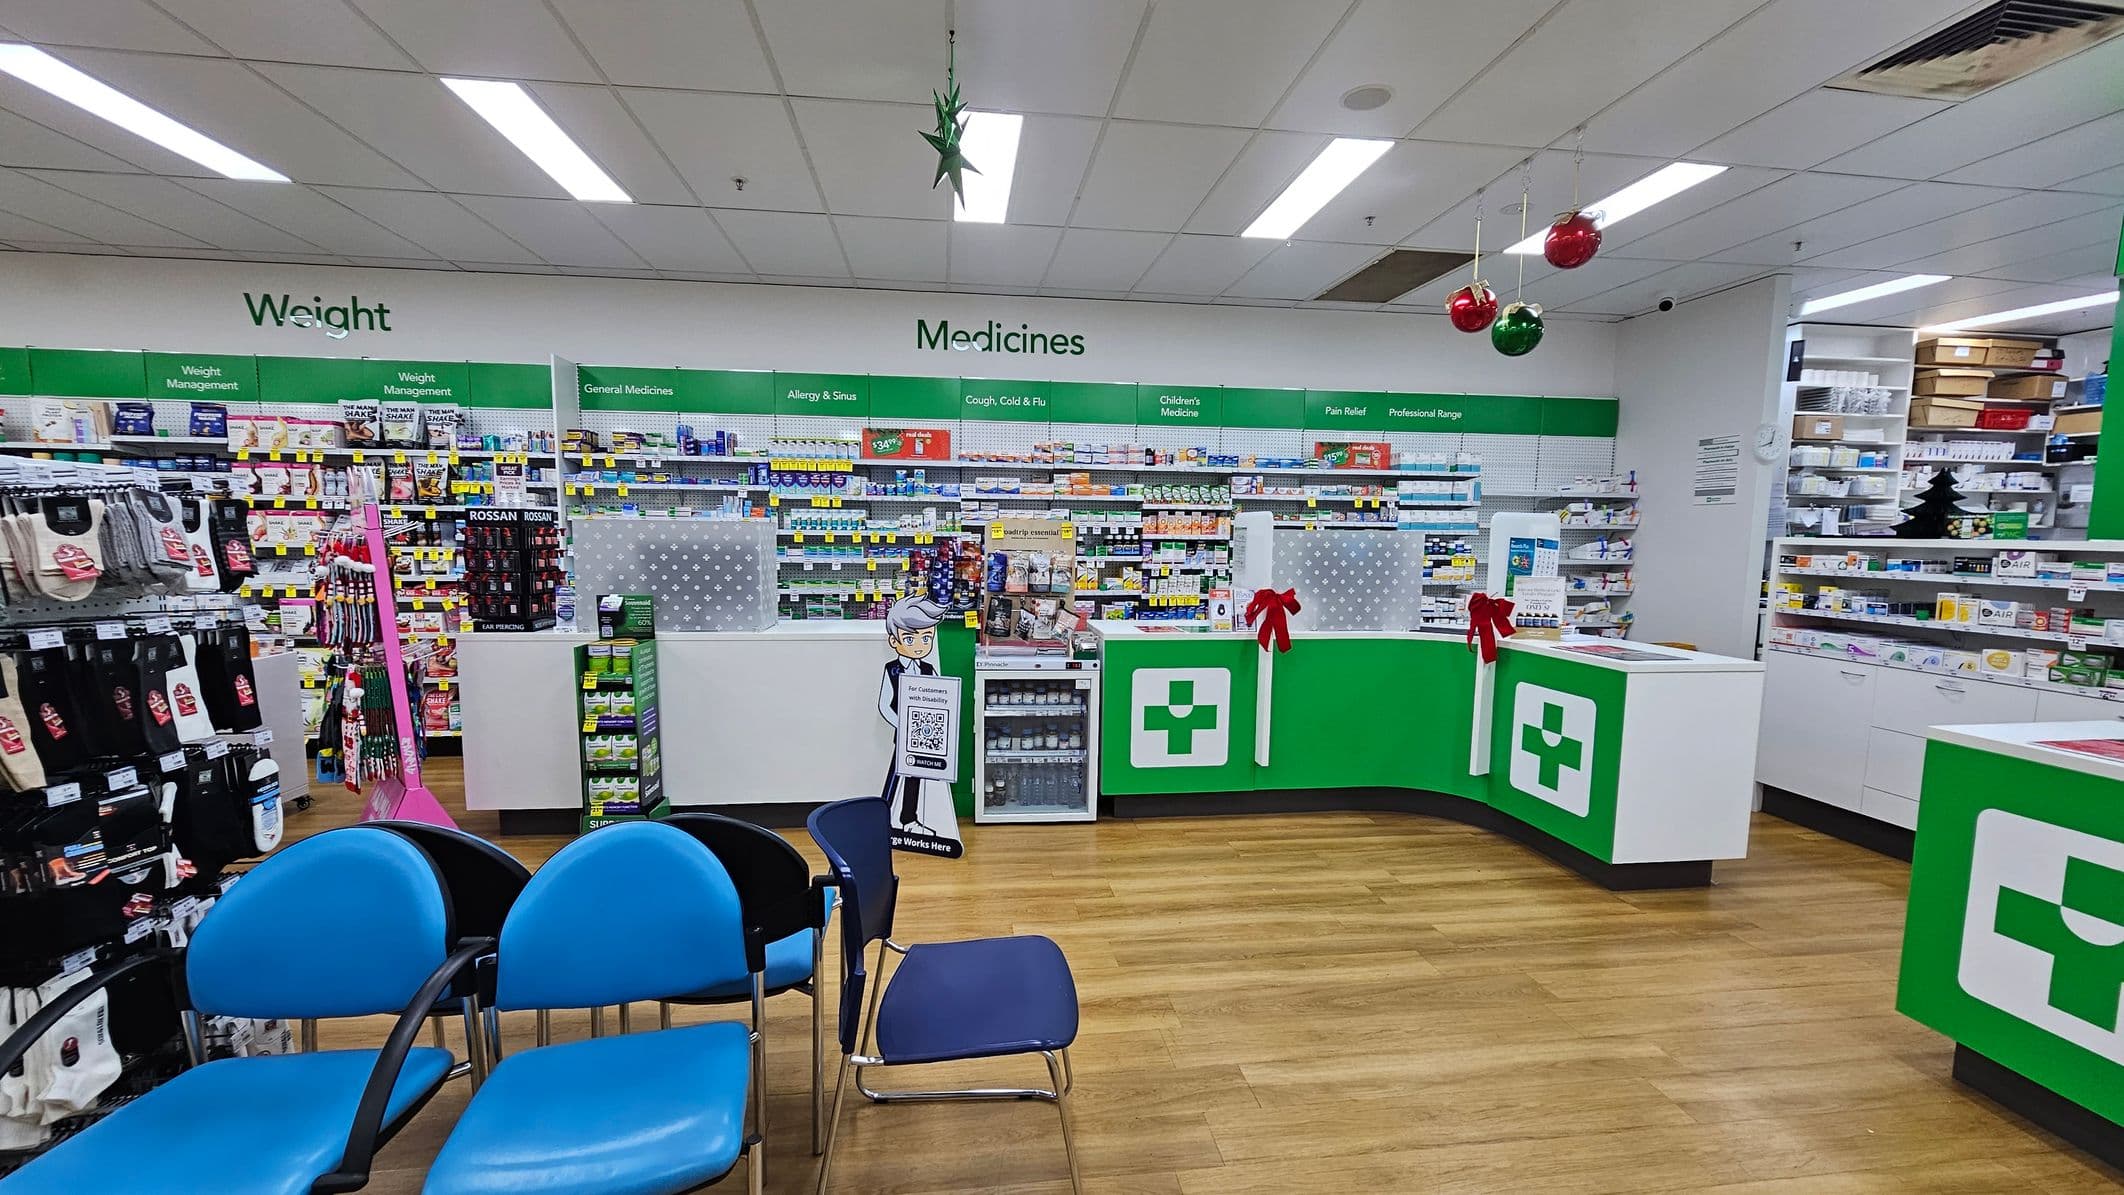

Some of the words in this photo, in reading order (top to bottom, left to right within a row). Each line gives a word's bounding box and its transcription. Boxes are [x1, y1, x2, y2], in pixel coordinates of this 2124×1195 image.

[243, 292, 392, 340] Weight
[917, 319, 1085, 356] Medicines
[181, 365, 222, 378] Weight
[398, 371, 436, 384] Weight
[166, 378, 239, 391] Management
[583, 384, 623, 394] General
[625, 385, 674, 396] Medicines
[383, 385, 452, 397] Management
[787, 389, 820, 402] Allergy
[822, 390, 831, 400] &
[833, 391, 857, 401] Sinus
[965, 395, 998, 407] Cough,
[999, 396, 1021, 406] Cold
[1022, 397, 1031, 406] &
[1032, 397, 1046, 406] Flu
[1159, 395, 1201, 406] Children's
[1160, 407, 1199, 418] Medicine
[1325, 406, 1343, 416] Pain
[1344, 407, 1368, 416] Relief
[1388, 408, 1436, 418] Professional
[1437, 409, 1463, 420] Range
[469, 510, 518, 521] ROSSAN
[524, 511, 552, 521] ROSSAN
[1003, 528, 1029, 537] oadtrip
[2011, 560, 2031, 569] AIR
[1992, 611, 2013, 619] AIR
[495, 623, 525, 631] PIERCING
[637, 619, 653, 627] 60%
[918, 686, 948, 694] Customers
[922, 696, 948, 705] Disability
[903, 836, 930, 849] Works
[931, 841, 952, 853] Here
